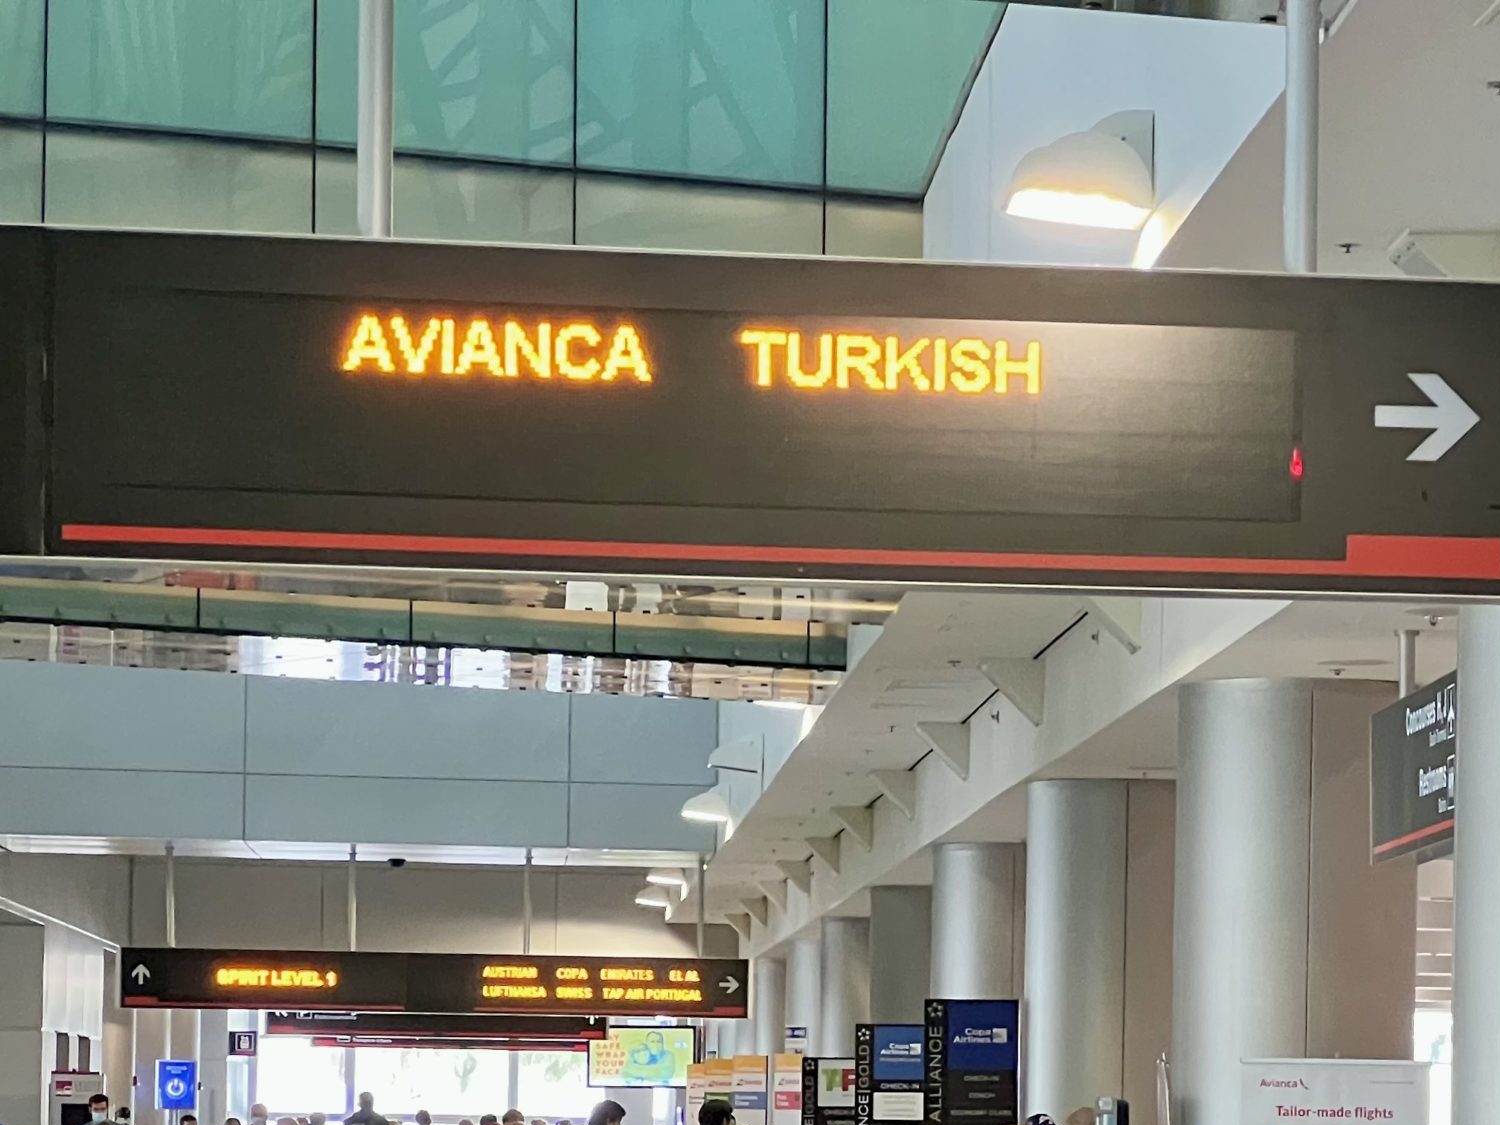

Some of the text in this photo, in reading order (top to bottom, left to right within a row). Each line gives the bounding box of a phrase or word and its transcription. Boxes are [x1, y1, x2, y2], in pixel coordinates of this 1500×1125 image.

[342, 315, 1041, 394] AVIANCA TURKISH
[1419, 766, 1446, 797] Restrooms
[217, 968, 337, 987] SPIRIT LEVEL 1
[483, 966, 538, 978] AUSTRIAN
[556, 968, 588, 980] COPA
[600, 968, 654, 981] EMIRATES
[669, 970, 683, 981] EL
[483, 985, 702, 1001] LUFTHANSA SWISS TAP AIR PORTUGAL
[953, 1035, 991, 1043] Airlines
[965, 1028, 991, 1036] Copa
[928, 1026, 942, 1122] ALLIANCE
[1260, 1078, 1298, 1088] Avianca
[1276, 1105, 1394, 1120] Tailor-made flights
